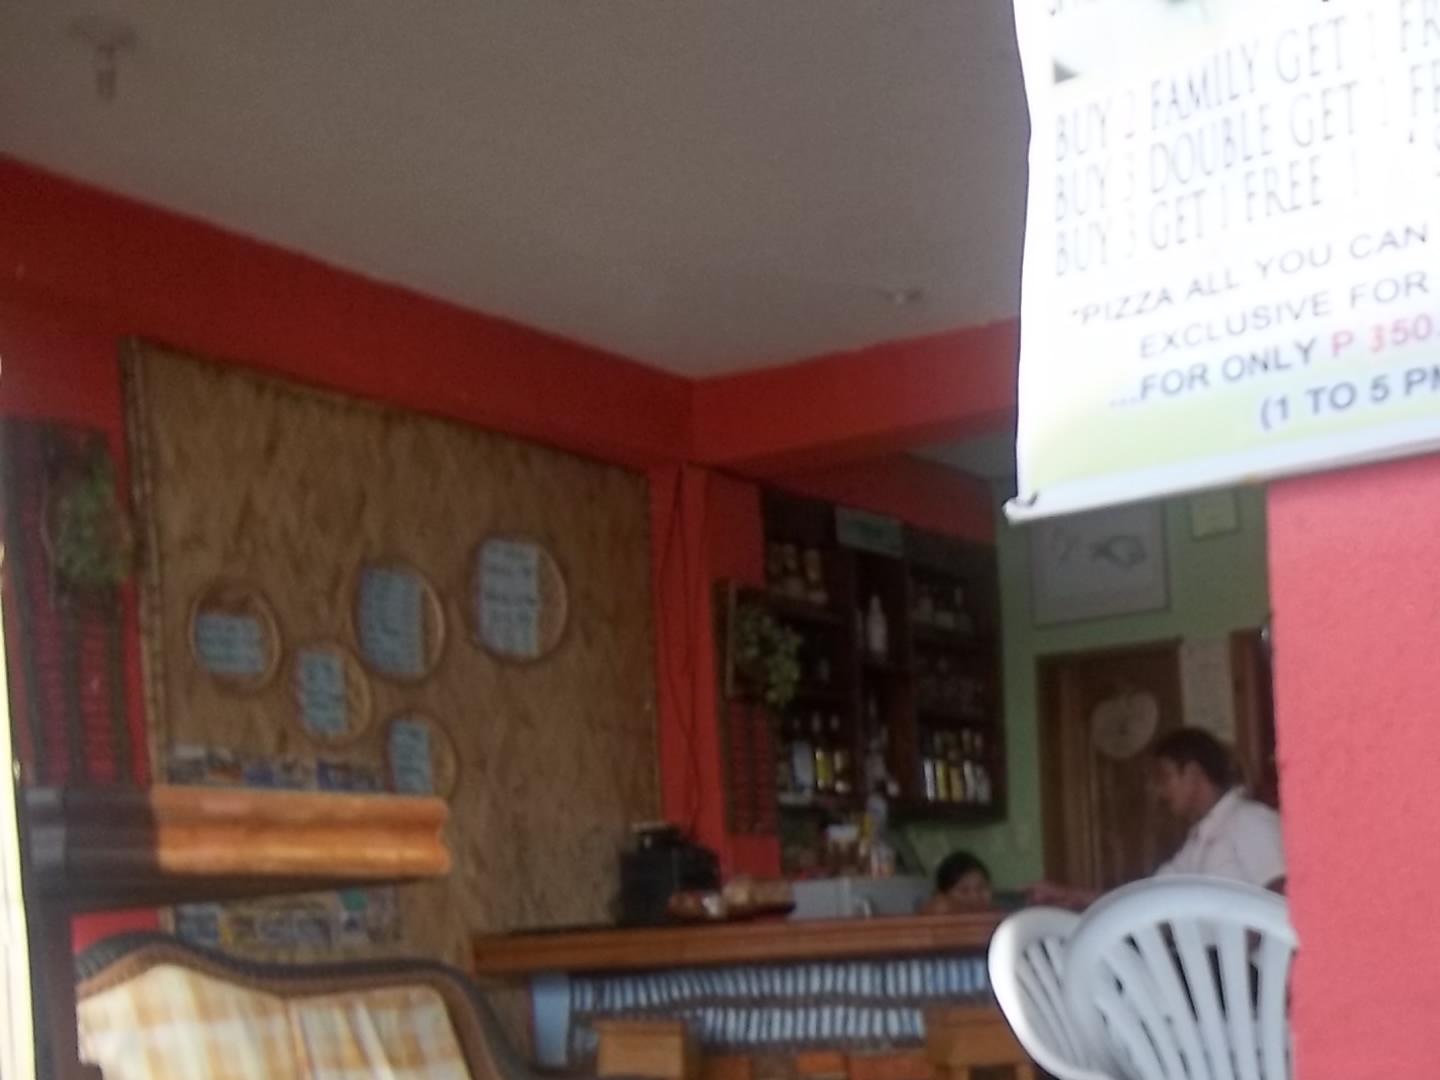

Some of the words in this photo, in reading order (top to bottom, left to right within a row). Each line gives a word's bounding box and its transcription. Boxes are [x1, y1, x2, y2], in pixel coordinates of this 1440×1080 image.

[1055, 96, 1112, 163] BUY
[1151, 37, 1260, 131] FAMILY
[1275, 15, 1346, 84] GET
[1055, 158, 1112, 222] BUY
[1149, 103, 1274, 195] DOUBLE
[1288, 79, 1359, 148] GET
[1055, 216, 1112, 277] BUY
[1149, 187, 1206, 251] GET
[1187, 267, 1241, 301] ALL
[1255, 242, 1334, 281] YOU
[1349, 222, 1430, 260] CAN
[1139, 290, 1333, 360] EXCLUSIVE
[1349, 270, 1431, 309] FOR
[1221, 336, 1319, 383] ONLY
[1260, 394, 1290, 432] (1
[1306, 381, 1358, 416] TO
[1369, 374, 1391, 405] 5
